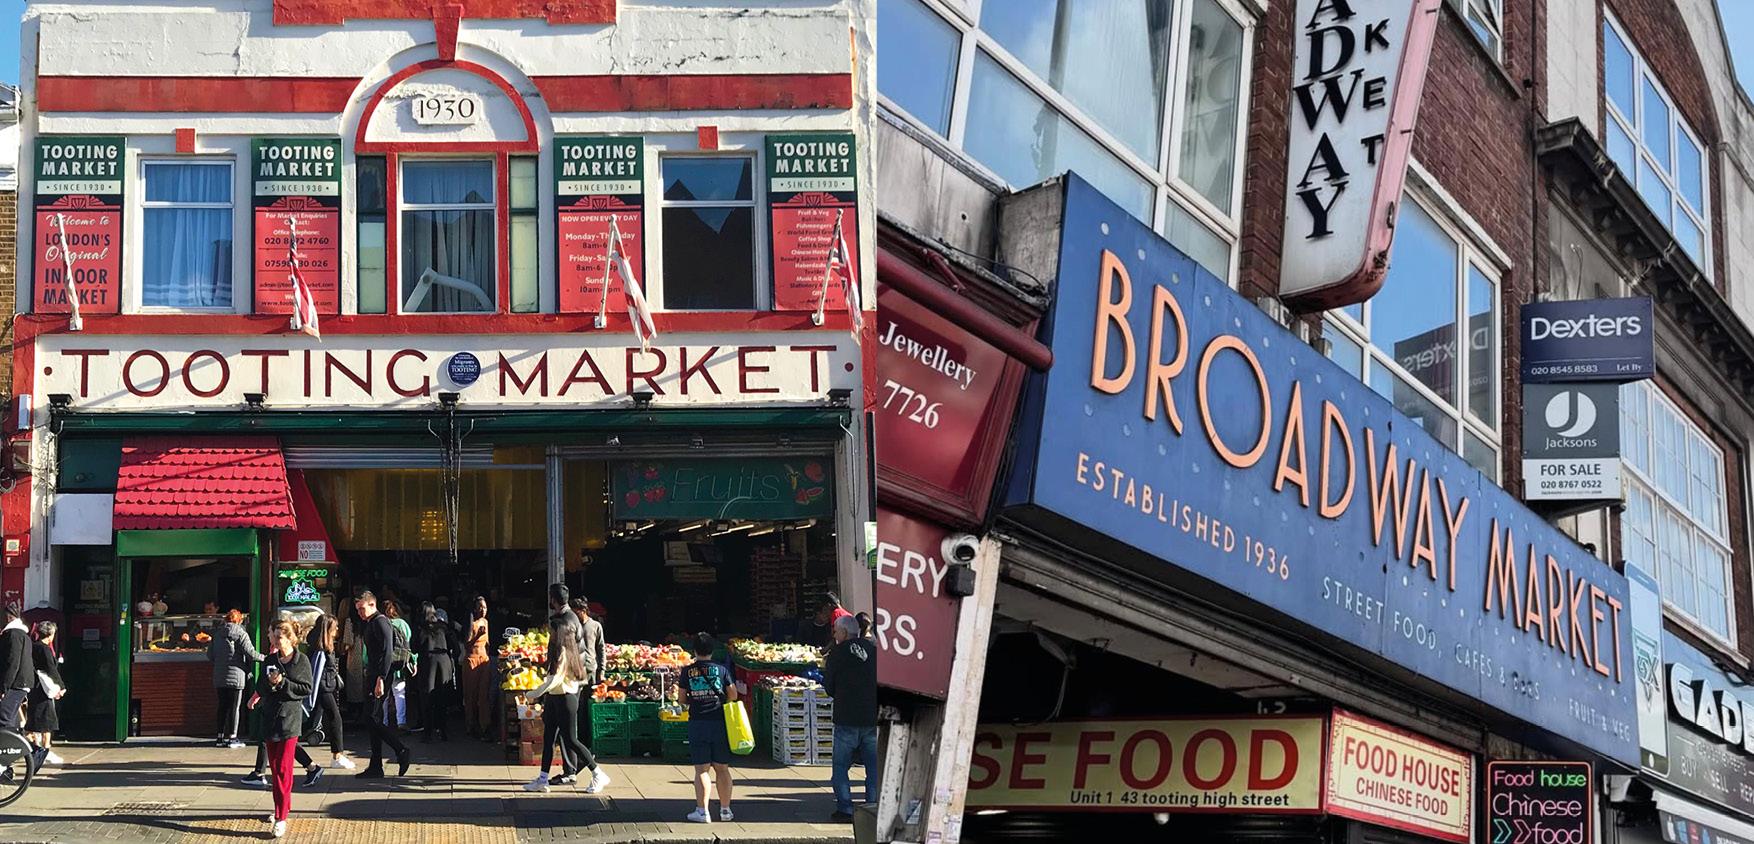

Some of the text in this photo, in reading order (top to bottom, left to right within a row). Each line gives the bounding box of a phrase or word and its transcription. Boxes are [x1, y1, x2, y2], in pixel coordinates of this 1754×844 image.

[1361, 18, 1391, 164] KET
[420, 98, 474, 120] 1930
[41, 145, 118, 159] TOOTING
[259, 146, 335, 160] TOOTING
[561, 145, 637, 160] TOOTING
[774, 142, 849, 157] TOOTING
[41, 161, 117, 176] MARKET
[260, 162, 334, 177] MARKET
[562, 161, 636, 176] MARKET
[775, 158, 849, 173] MARKET
[84, 184, 105, 192] 1930
[271, 184, 323, 192] SINCE 1930
[574, 184, 600, 192] SINCE
[100, 215, 109, 225] to
[264, 237, 281, 245] 020
[307, 237, 330, 245] 4760
[44, 288, 108, 304] MAKET
[1531, 314, 1641, 341] Dexters
[879, 320, 977, 391] Jewellery
[61, 345, 838, 398] TOOTING MARKET
[1531, 366, 1549, 375] 020
[1550, 365, 1573, 374] 8545
[1574, 364, 1598, 373] 8583
[883, 379, 943, 429] 7726
[1091, 249, 1470, 591] BROADWAY
[1545, 437, 1597, 450] Jacksons
[1540, 463, 1601, 476] FOR SALE
[670, 467, 781, 501] Fruits
[1540, 480, 1602, 488] 020 8767 0522
[1076, 452, 1290, 582] ESTABLISHED 1936
[299, 550, 309, 559] NO
[306, 569, 328, 577] FOOD
[877, 541, 949, 598] ERY
[1484, 518, 1623, 683] MARKET
[1323, 577, 1384, 624] STREET
[1455, 643, 1493, 678] CAFES
[1499, 666, 1505, 684] &
[1568, 698, 1597, 727] FRUIT
[1601, 715, 1608, 732] &
[1613, 718, 1631, 743] VEG
[1073, 728, 1299, 791] FOOD
[1344, 736, 1460, 797] FOOD HOUSE
[1681, 755, 1697, 777] BUY
[1494, 769, 1587, 787] Food house
[1070, 790, 1289, 808] Unit 1 43 tooting high street
[1356, 777, 1448, 816] CHINESE FOOD
[1492, 792, 1582, 817] Chinese
[1531, 821, 1584, 844] food
